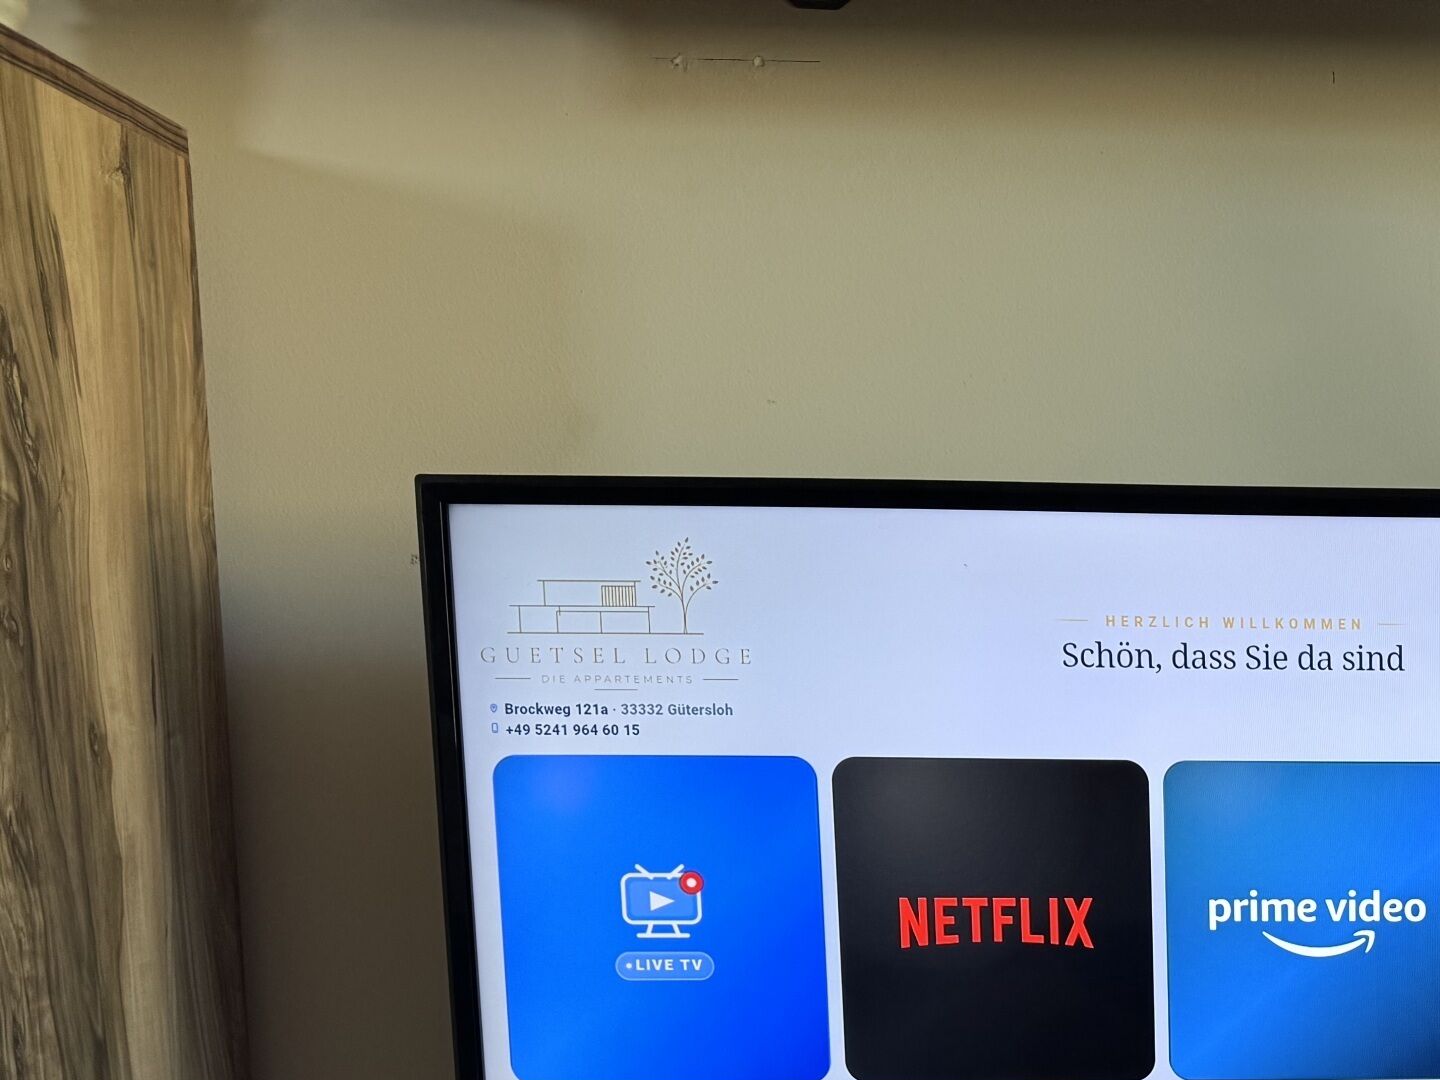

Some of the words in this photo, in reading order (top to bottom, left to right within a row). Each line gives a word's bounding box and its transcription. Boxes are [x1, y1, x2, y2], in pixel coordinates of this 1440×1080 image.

[1105, 615, 1210, 629] HERZLICH
[1222, 616, 1362, 630] WILLKOMMEN
[480, 646, 626, 664] GUETSEL
[644, 647, 752, 664] LODGE
[1062, 640, 1162, 674] Schön,
[1172, 642, 1237, 669] dass
[1245, 644, 1288, 670] Sie
[1298, 644, 1333, 670] da
[1342, 644, 1405, 671] sind
[542, 674, 566, 683] DIE
[574, 674, 694, 684] APPARTEMENTS
[504, 702, 570, 718] Brockweg
[576, 704, 608, 715] 121a
[620, 704, 664, 716] 33332
[668, 702, 733, 716] Gütersloh
[506, 724, 530, 736] +49
[535, 724, 568, 736] 5241
[573, 724, 598, 736] 964
[602, 724, 619, 736] 60
[624, 724, 640, 736] 15
[1208, 889, 1316, 930] prime
[1326, 889, 1427, 923] video
[899, 897, 1094, 949] NETFLIX
[635, 959, 676, 972] LIVE
[679, 959, 703, 972] TV
